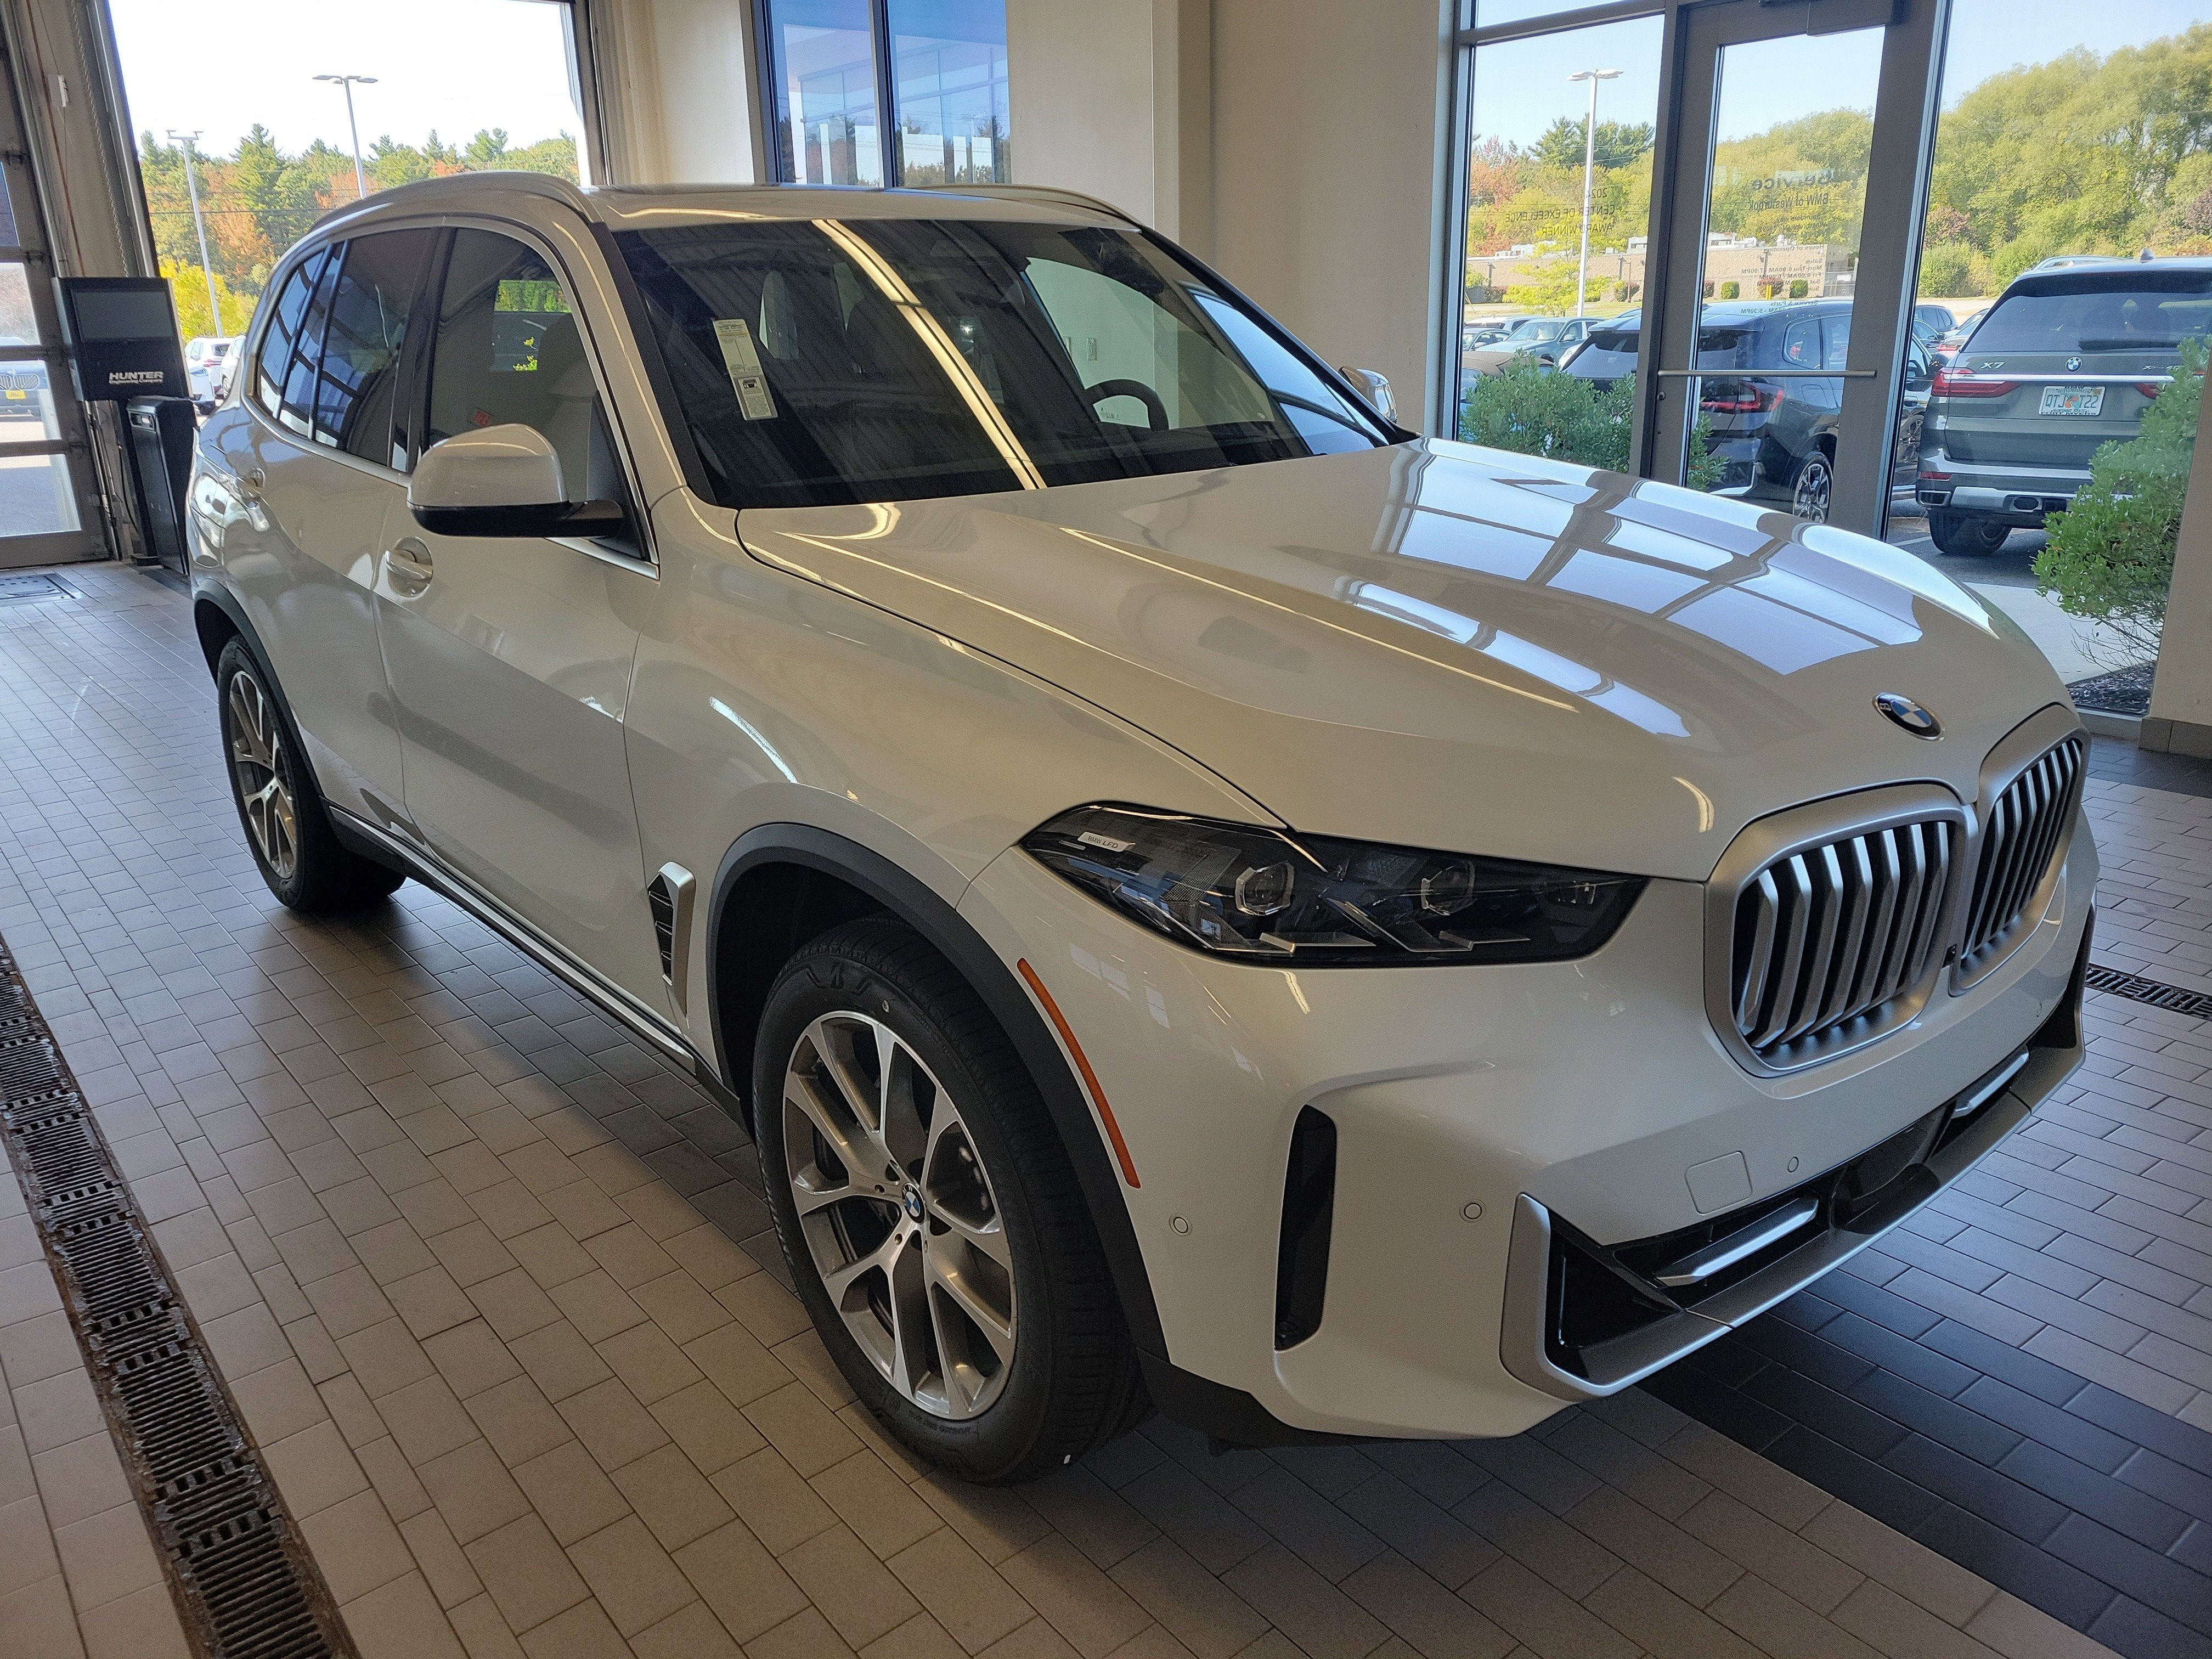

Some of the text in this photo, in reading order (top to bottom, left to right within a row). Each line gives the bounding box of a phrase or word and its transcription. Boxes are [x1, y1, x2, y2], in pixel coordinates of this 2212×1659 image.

[109, 371, 163, 380] HUNTER
[2045, 394, 2099, 408] QTJ T22
[1087, 836, 1102, 844] BMW
